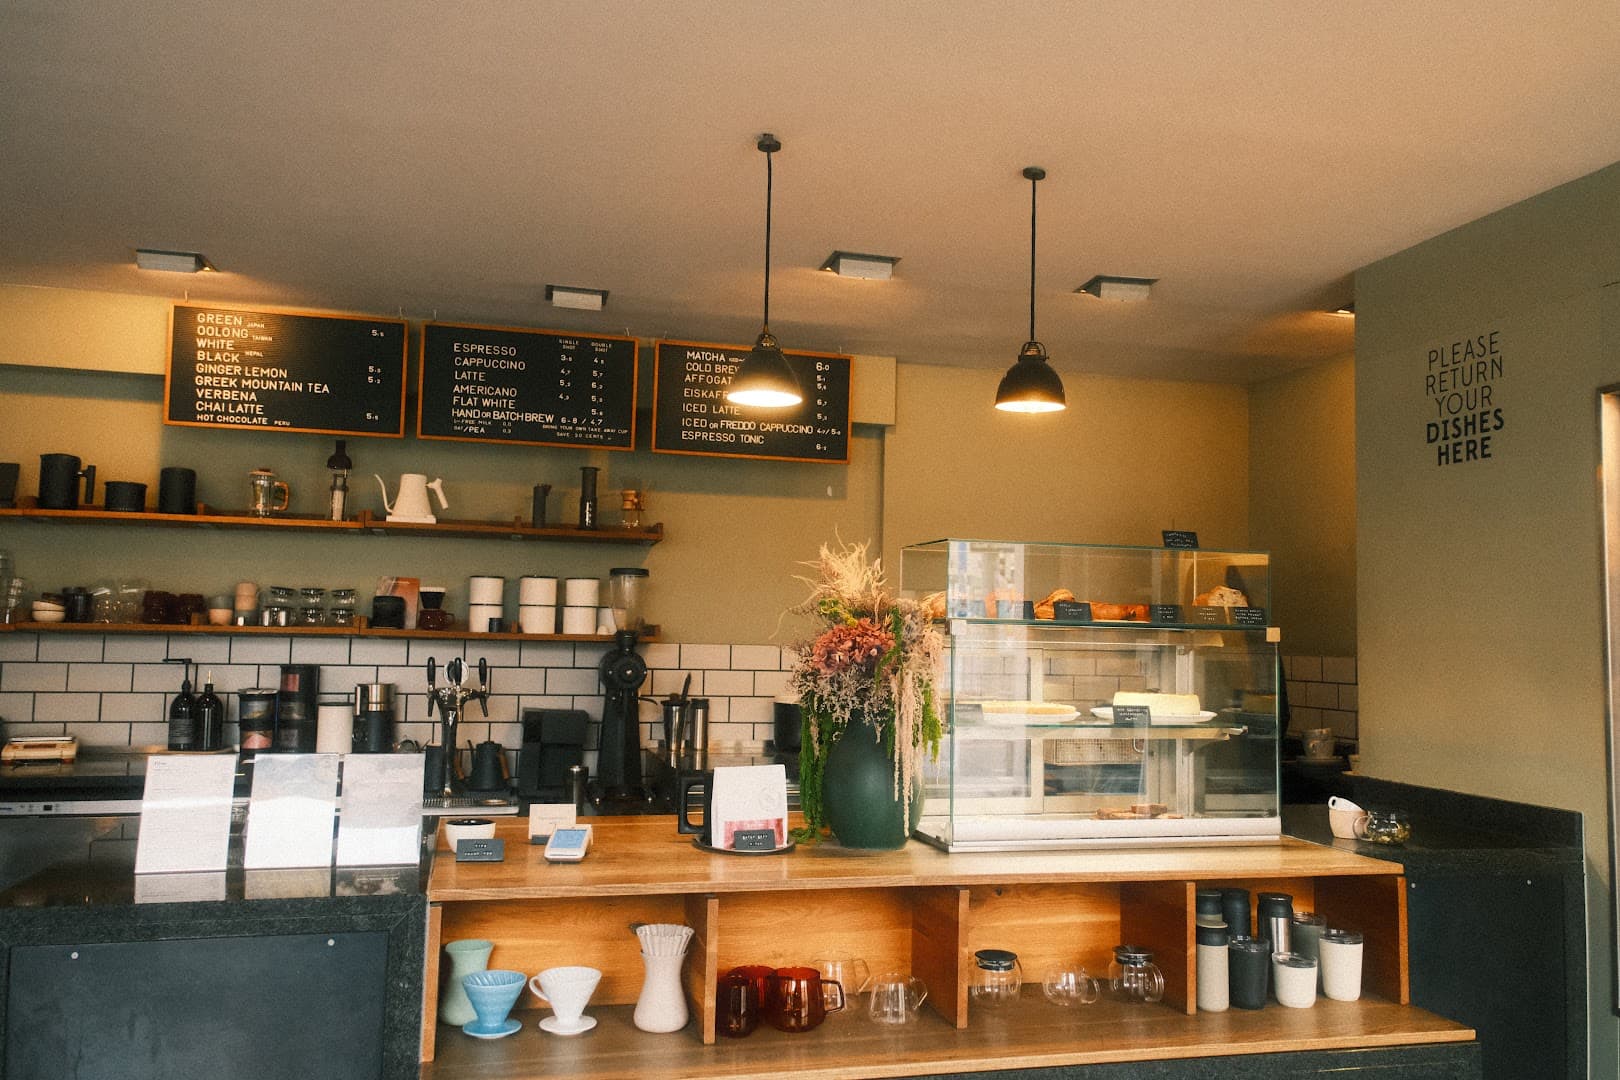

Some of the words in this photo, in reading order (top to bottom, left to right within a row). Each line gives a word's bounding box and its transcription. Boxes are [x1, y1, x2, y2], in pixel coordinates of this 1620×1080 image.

[197, 313, 242, 326] GREEN
[197, 326, 249, 338] OOLONG
[196, 338, 235, 350] WHITE
[454, 343, 517, 356] ESPRESSO
[197, 350, 240, 363] BLACK
[686, 350, 725, 362] MATCHA
[1428, 331, 1500, 372] PLEASE
[454, 357, 526, 370] CAPPUCCINO
[686, 362, 712, 372] COLD
[196, 363, 242, 376] GINGER
[245, 366, 287, 378] LEMON
[454, 370, 486, 381] LATTE
[1426, 355, 1503, 396] RETURN
[195, 376, 238, 388] GREEK
[242, 379, 302, 392] MOUNTAIN
[308, 383, 330, 394] TEA
[685, 374, 732, 384] AFFOGAT
[196, 388, 257, 402] VERBENA
[453, 385, 517, 397] AMERICANO
[196, 401, 224, 412] CHAI
[229, 403, 264, 414] LATTE
[453, 396, 478, 406] FLAT
[482, 398, 516, 409] WHITE
[1435, 385, 1492, 418] YOUR
[452, 408, 480, 418] HAND
[682, 403, 707, 413] ICED
[712, 406, 740, 415] LATTE
[216, 415, 268, 424] CHOCOLATE
[682, 418, 707, 428] ICED
[720, 420, 756, 430] FREDDO
[760, 422, 813, 434] CAPPUCCINO
[1426, 408, 1504, 444] DISHES
[682, 431, 735, 442] ESPRESSO
[741, 434, 765, 444] TONIC
[1438, 436, 1492, 466] HERE
